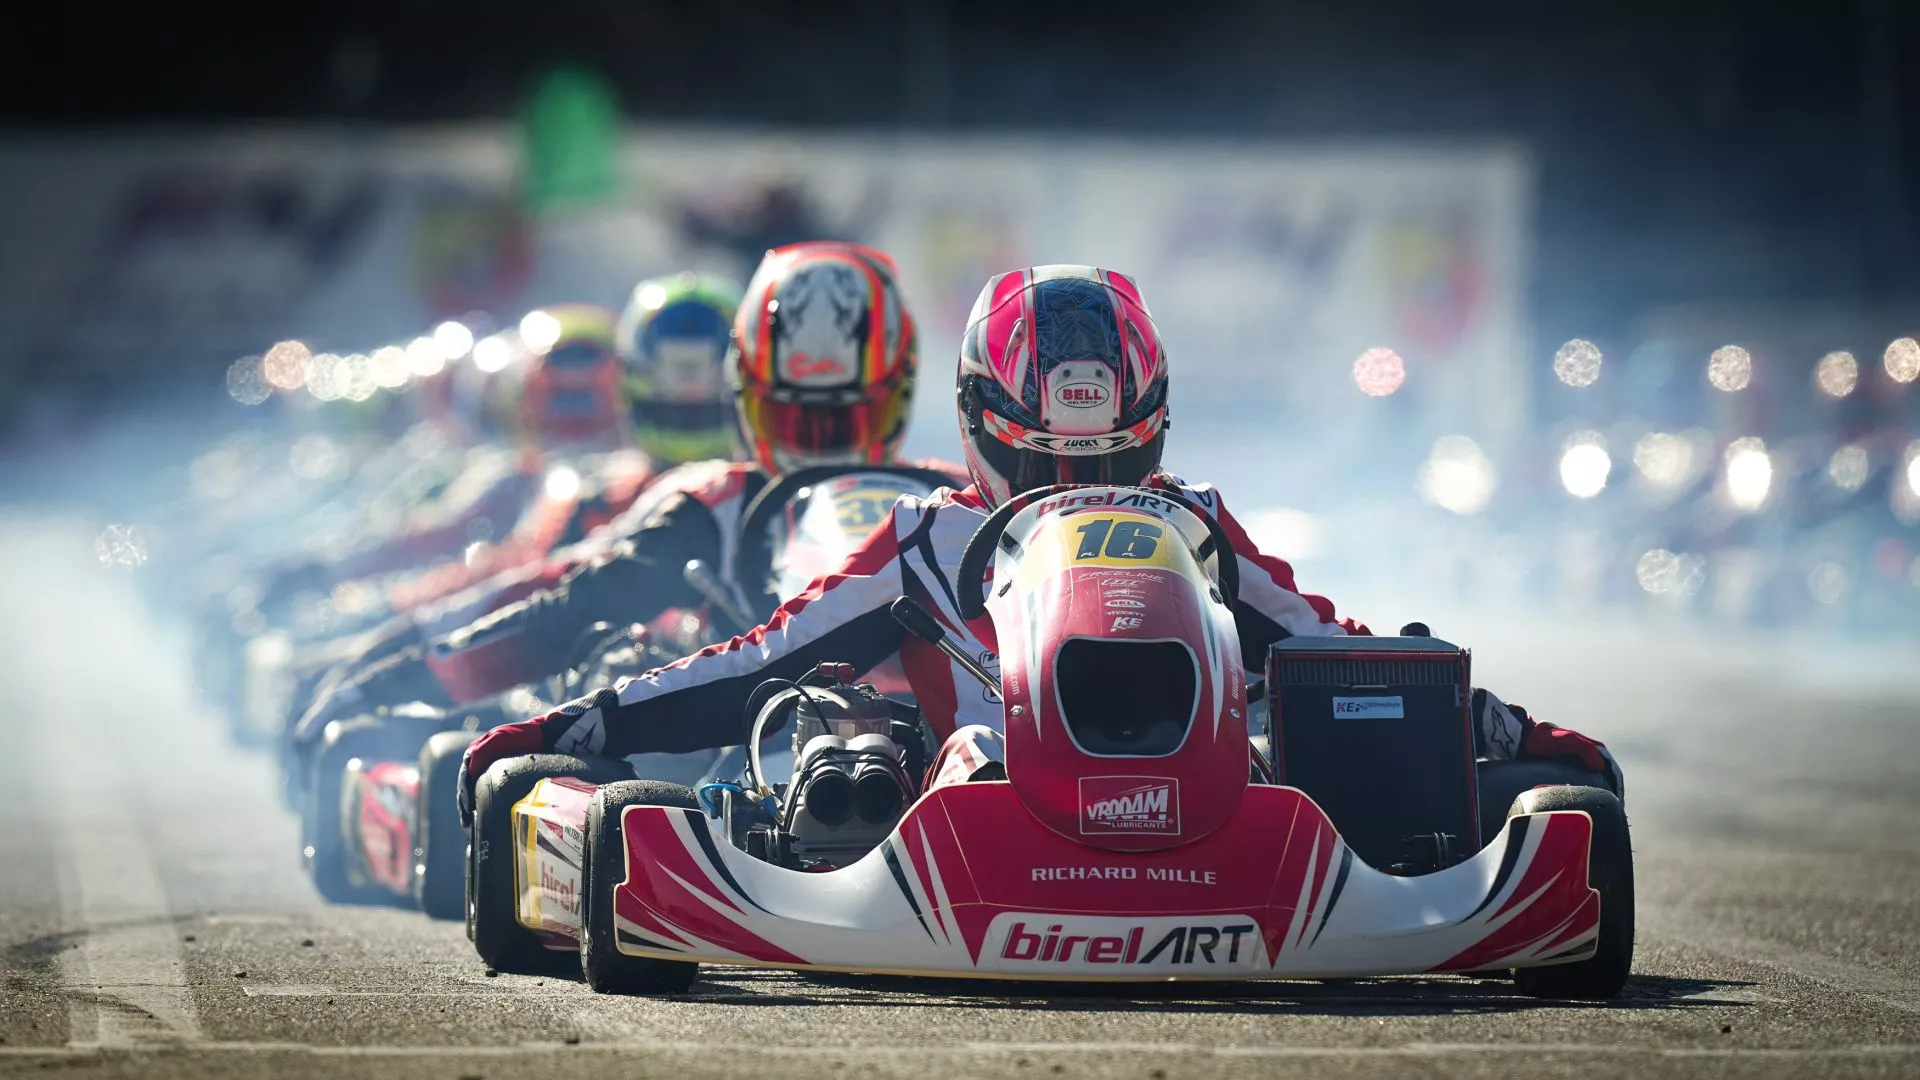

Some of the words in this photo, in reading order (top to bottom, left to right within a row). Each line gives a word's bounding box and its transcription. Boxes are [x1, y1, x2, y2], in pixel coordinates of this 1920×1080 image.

[1063, 389, 1103, 400] BELL
[1063, 439, 1099, 447] LUCKY
[1037, 492, 1180, 518] birelART
[1075, 518, 1163, 561] 16
[1111, 821, 1167, 829] LUBRICANTS
[1032, 867, 1137, 881] RICHARD
[1147, 868, 1217, 884] MILLE
[1000, 922, 1254, 965] birelART
